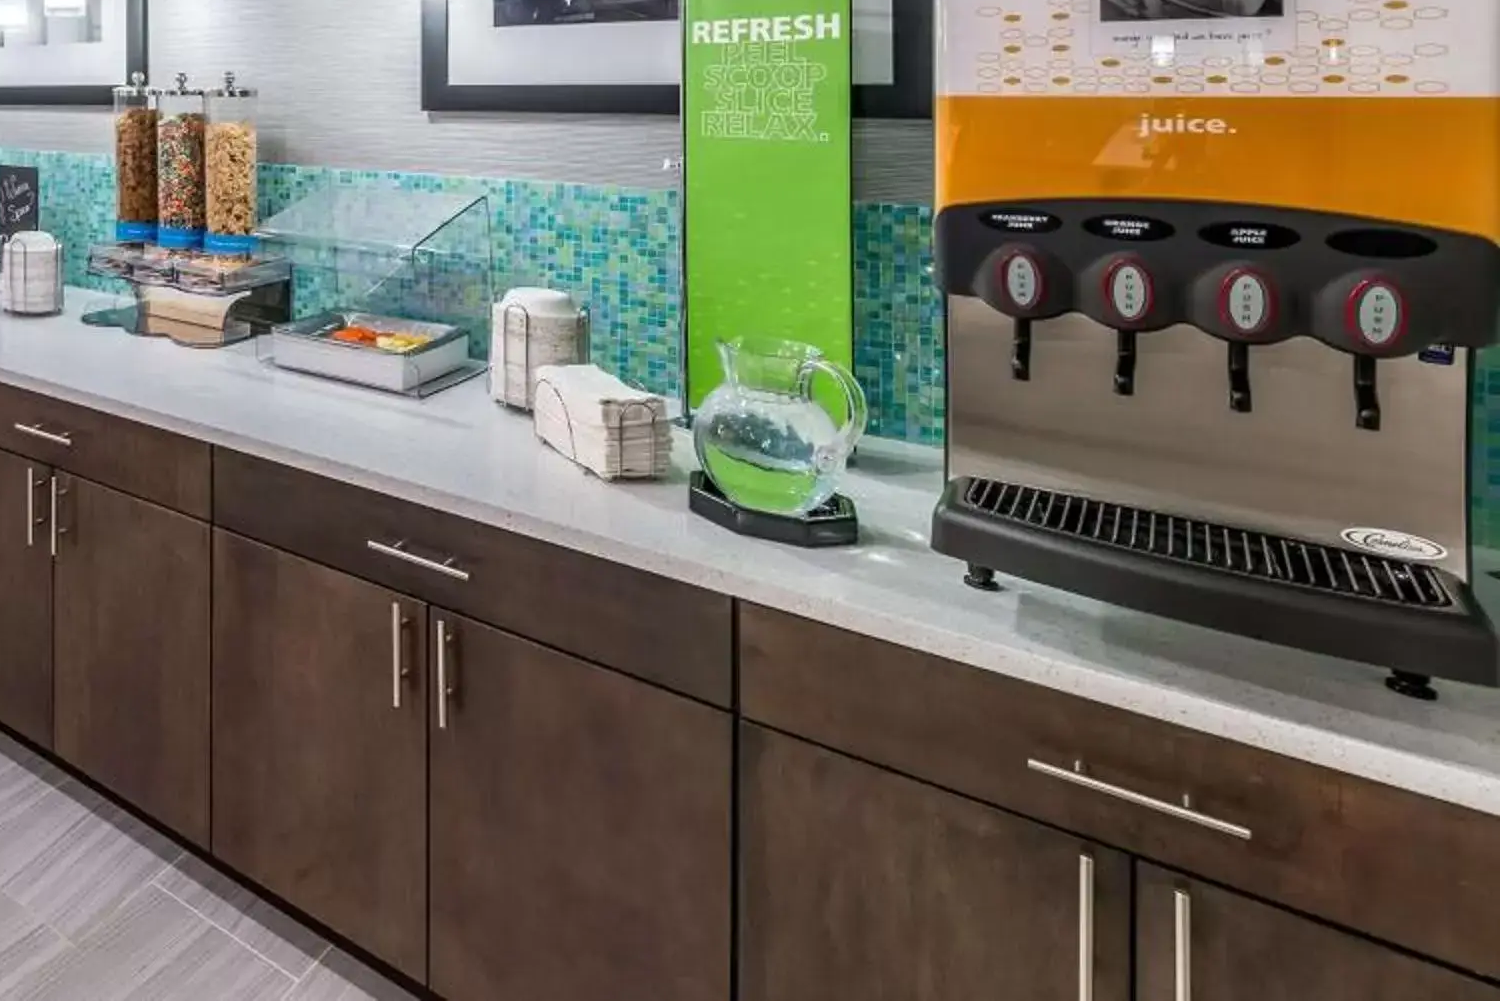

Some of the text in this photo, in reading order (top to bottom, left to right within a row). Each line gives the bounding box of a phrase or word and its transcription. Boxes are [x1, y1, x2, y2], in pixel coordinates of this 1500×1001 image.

[692, 13, 841, 44] REFRESH
[721, 41, 807, 65] PEEL
[703, 62, 827, 89] SCOOP
[715, 87, 813, 115] SLICE
[701, 110, 829, 142] RELAX.
[1137, 112, 1237, 138] juice.
